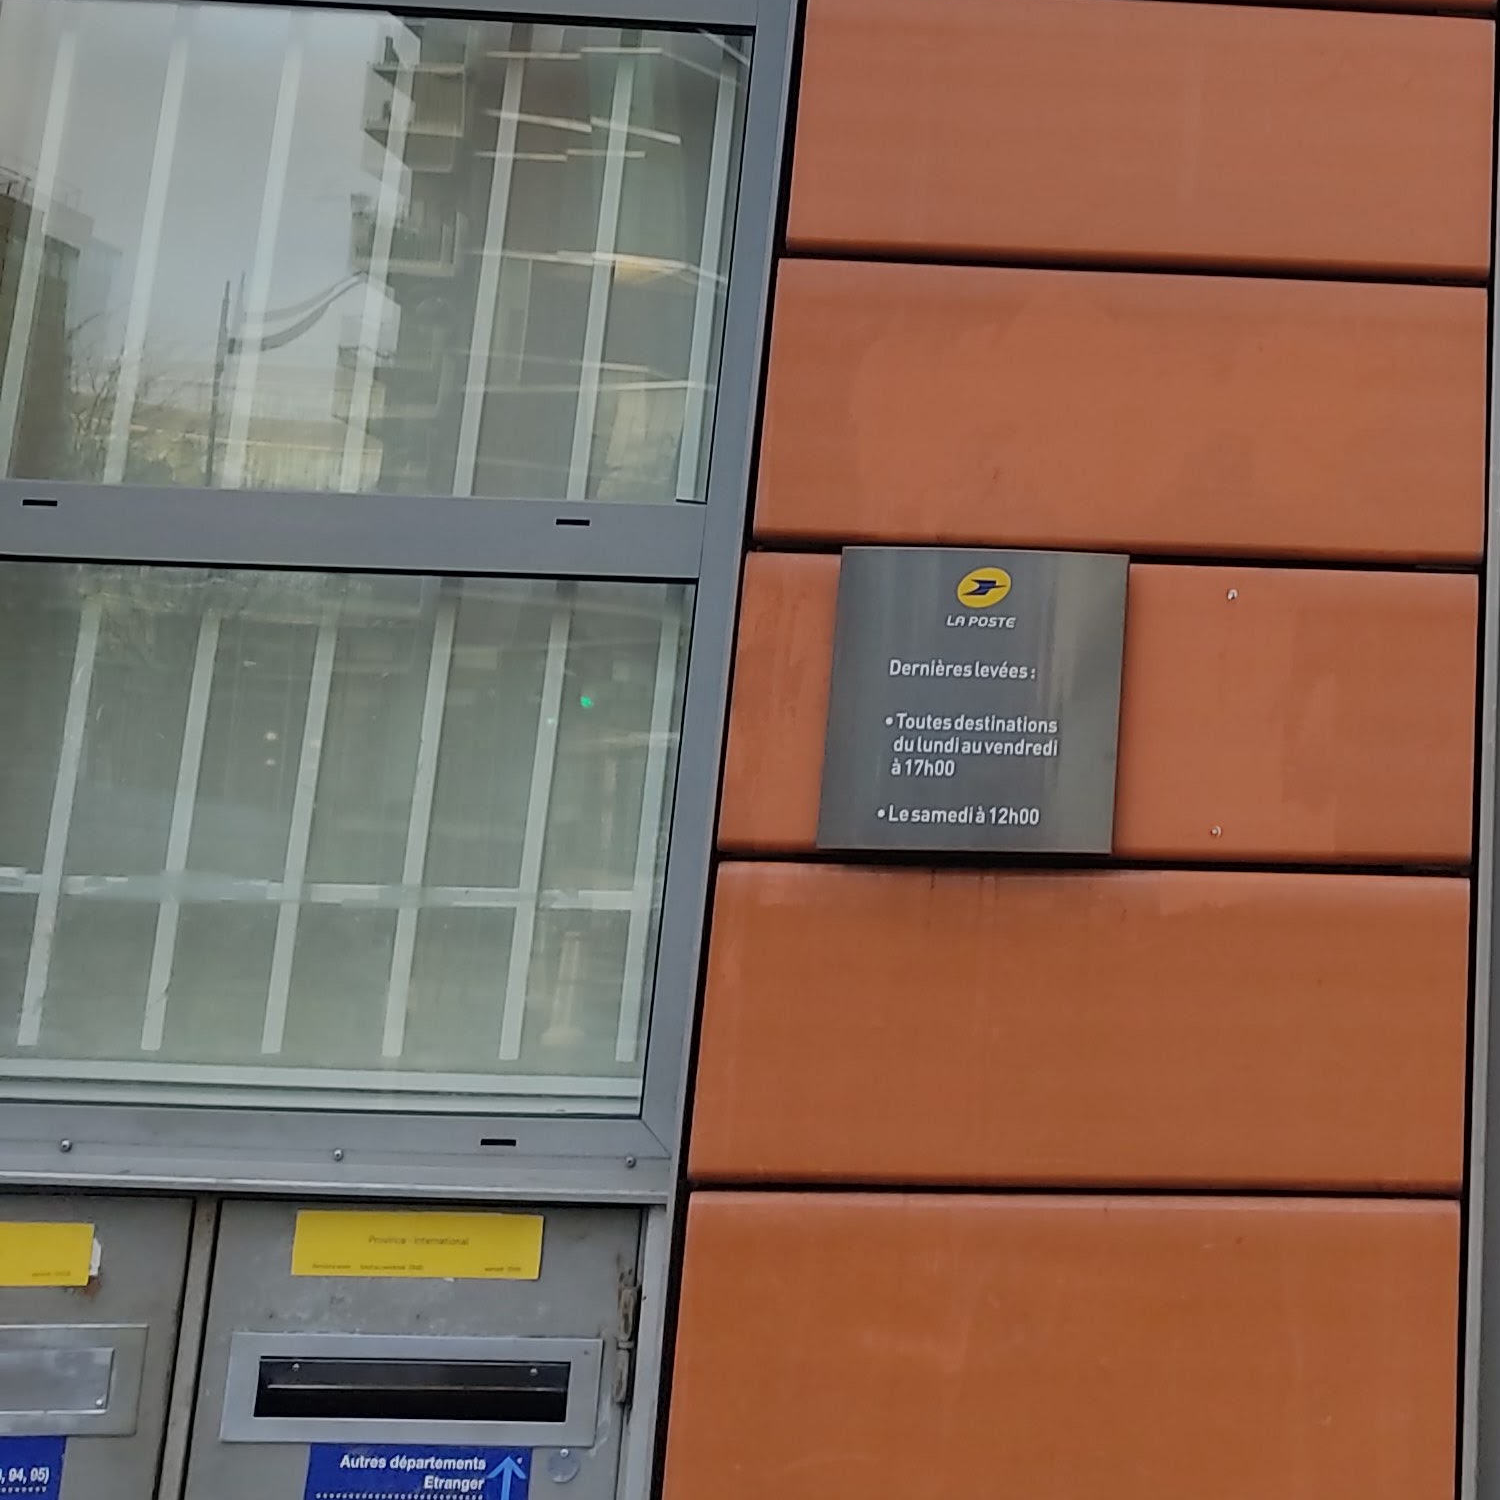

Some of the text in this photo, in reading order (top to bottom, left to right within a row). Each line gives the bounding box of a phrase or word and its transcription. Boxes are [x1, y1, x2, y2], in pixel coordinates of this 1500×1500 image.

[946, 615, 1017, 629] LA POSTE
[889, 658, 973, 678] Dernières
[896, 711, 1058, 734] Toutes destinations
[893, 736, 1058, 757] du lundi au vendredi
[890, 757, 955, 777] à 17h00
[888, 805, 1040, 826] Le samedi à 12h00
[340, 1454, 486, 1471] Autres départements
[423, 1474, 485, 1492] Etranger
